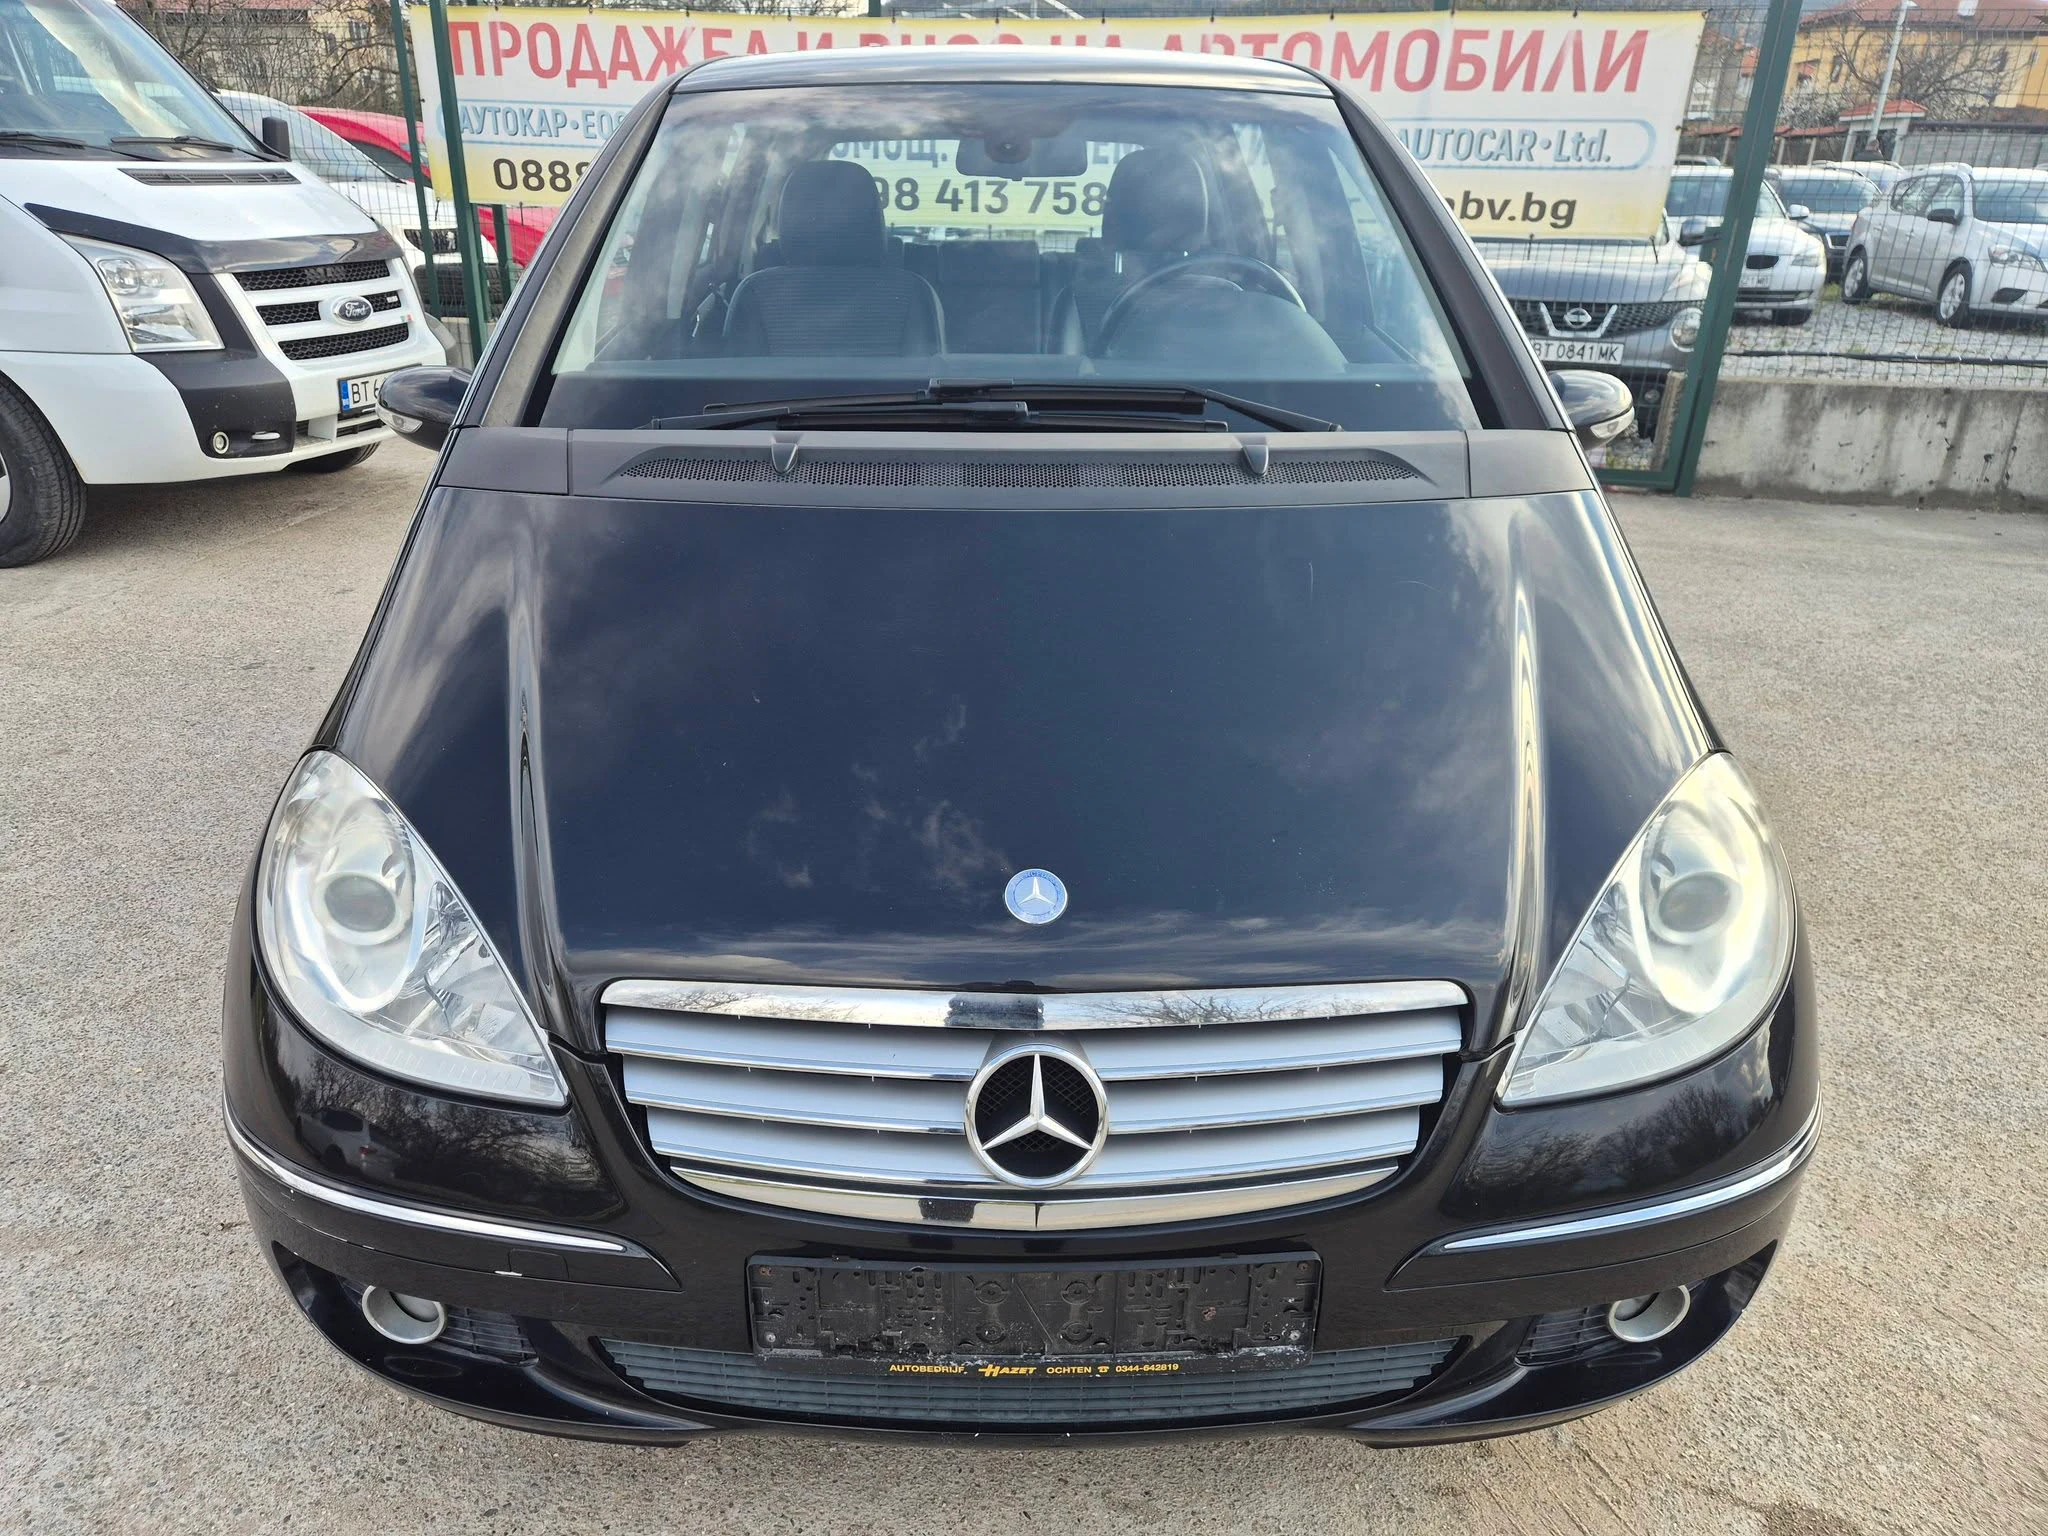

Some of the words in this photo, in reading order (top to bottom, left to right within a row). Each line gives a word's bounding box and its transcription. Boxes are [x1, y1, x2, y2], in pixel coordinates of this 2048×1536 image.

[935, 179, 1009, 214] 413
[1023, 181, 1107, 216] 758
[345, 301, 370, 318] Ford
[1556, 342, 1594, 361] 0841
[1599, 346, 1618, 362] MK
[351, 380, 370, 404] BT
[889, 1364, 966, 1374] AUTOBEDRIJF
[978, 1364, 1037, 1377] HAZET
[1046, 1366, 1092, 1374] OCHTEN
[1115, 1363, 1180, 1373] 0344-642819
